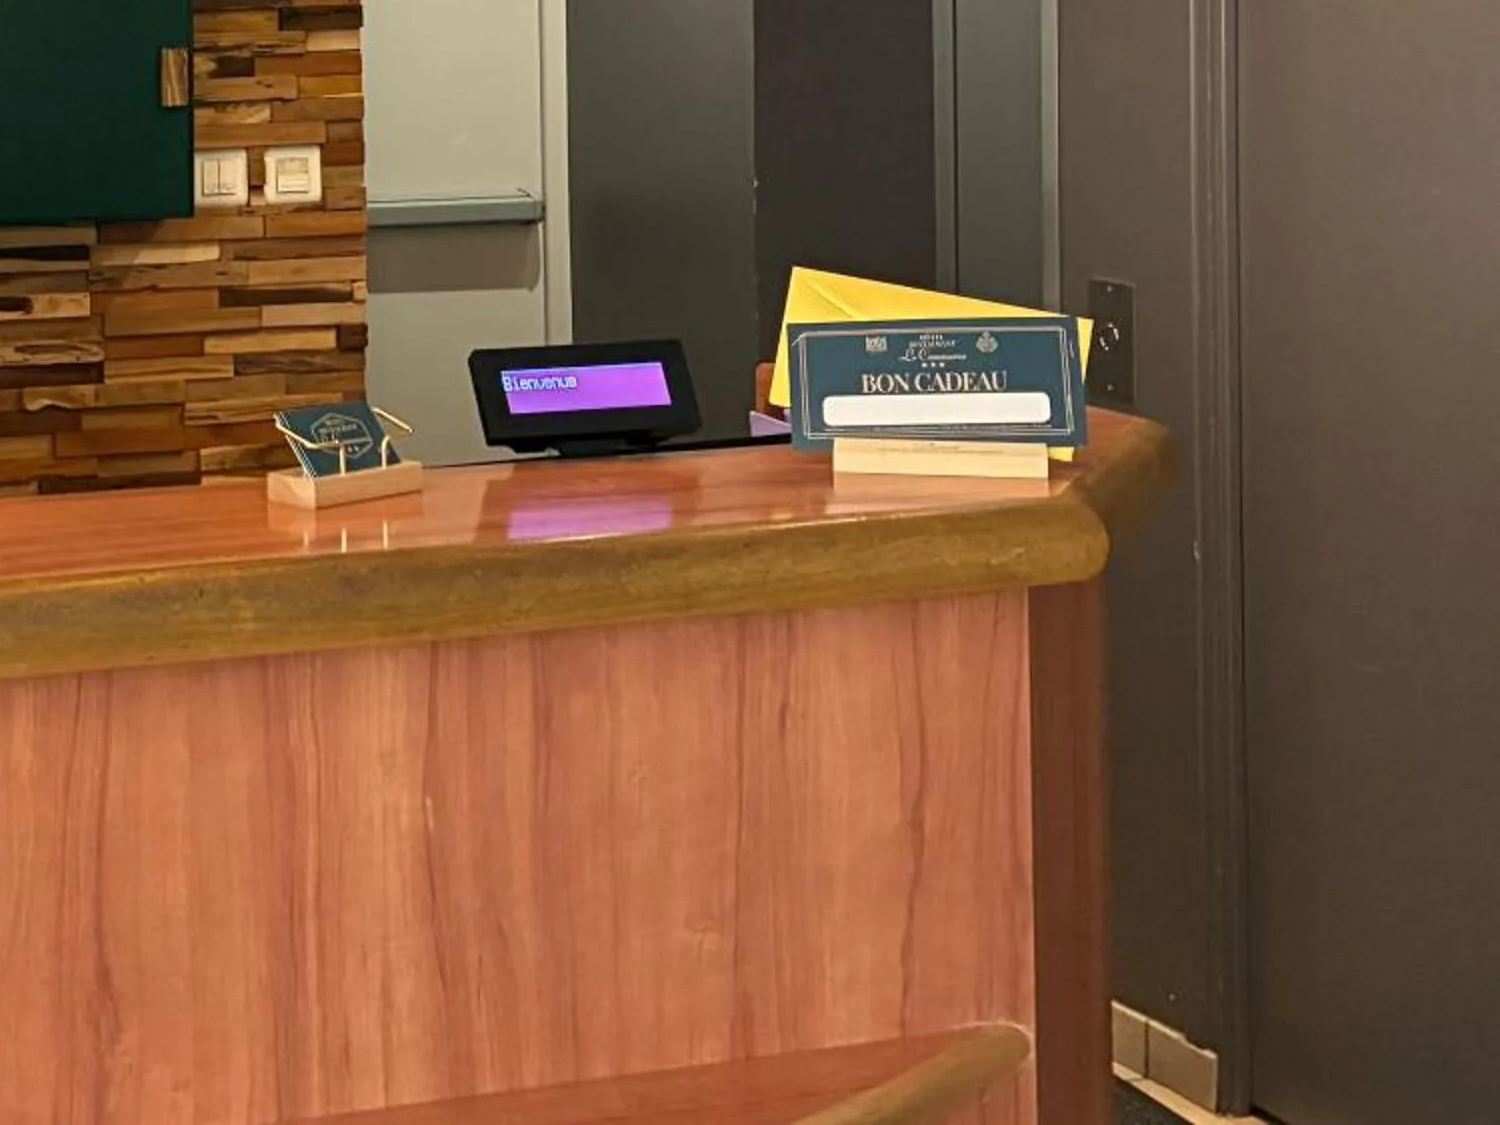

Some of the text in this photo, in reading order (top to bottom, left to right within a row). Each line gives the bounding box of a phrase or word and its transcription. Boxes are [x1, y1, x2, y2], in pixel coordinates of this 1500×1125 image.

[501, 375, 578, 393] Bienvenue
[861, 370, 1008, 394] BON CADEAU
